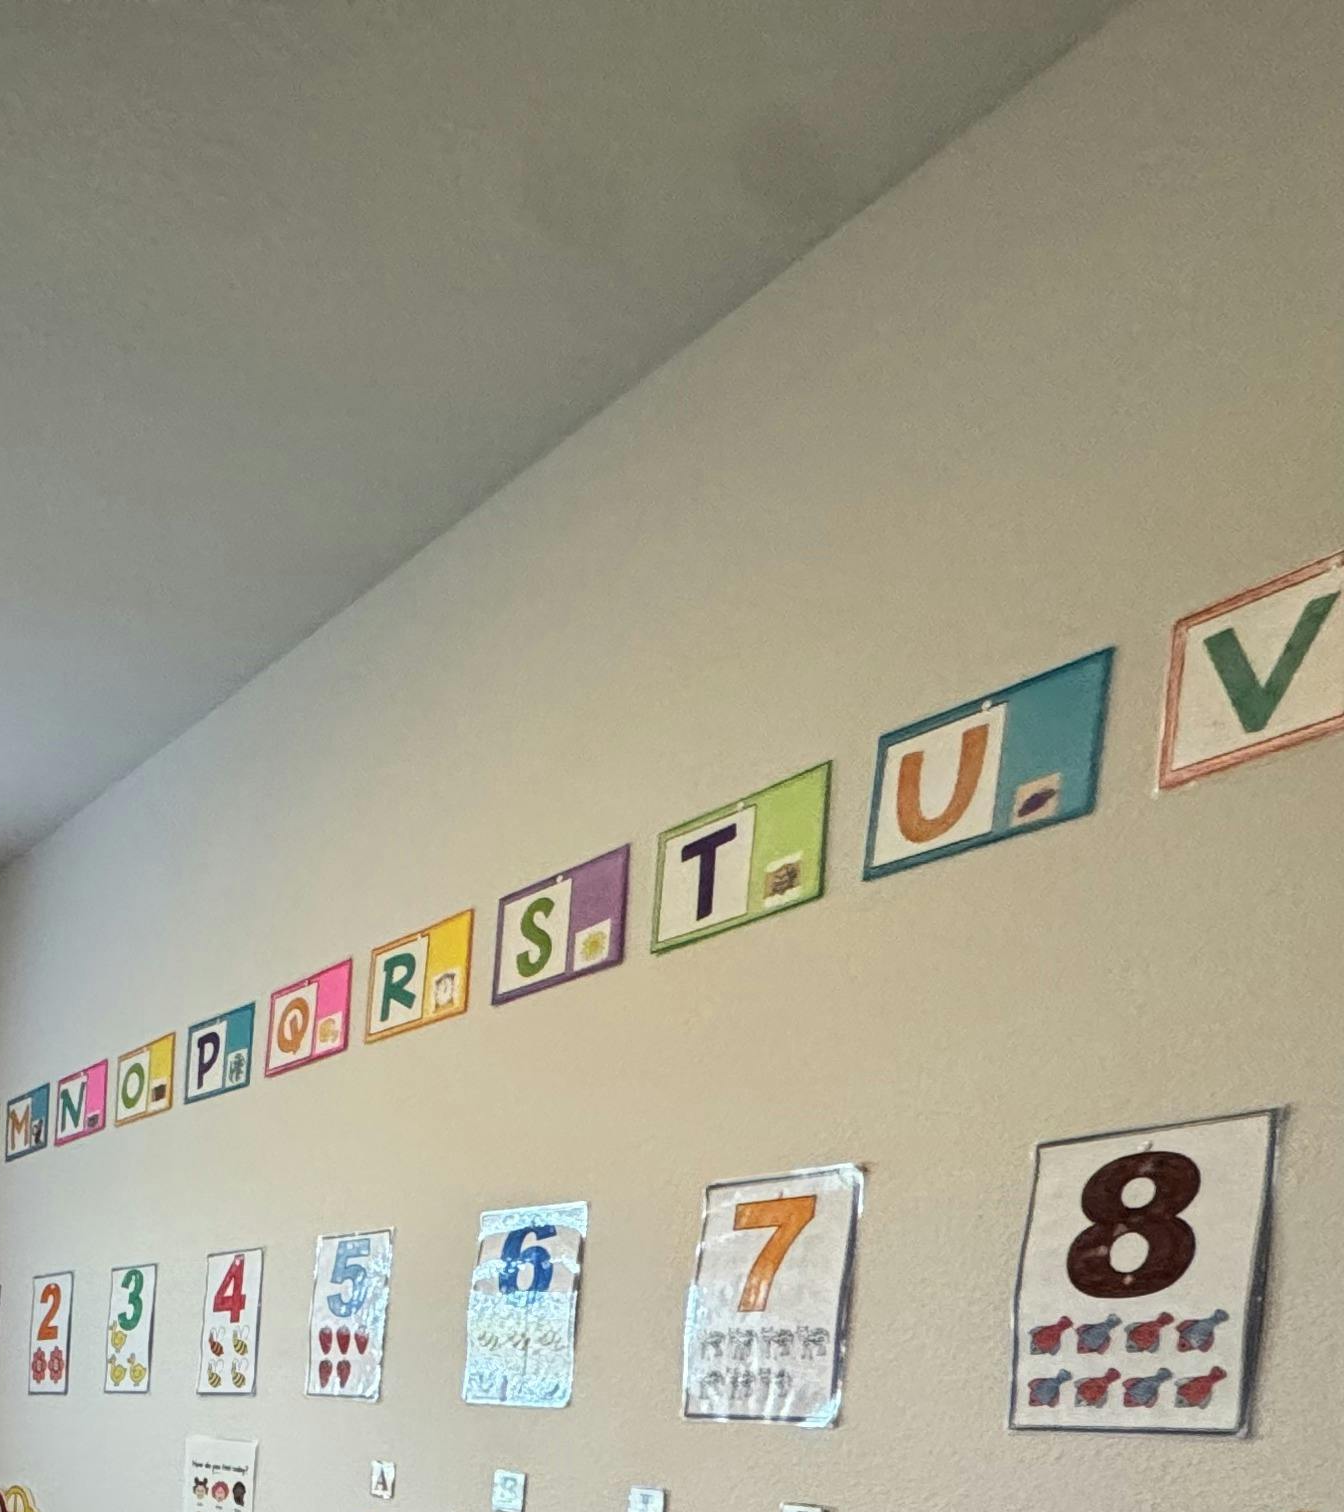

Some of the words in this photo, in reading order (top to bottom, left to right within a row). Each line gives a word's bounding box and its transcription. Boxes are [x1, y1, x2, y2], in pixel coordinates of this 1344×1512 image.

[1203, 590, 1341, 733] V
[896, 724, 990, 844] U
[681, 822, 737, 922] T
[516, 897, 554, 978] S
[380, 952, 417, 1022] R
[278, 997, 310, 1054] Q
[121, 1062, 145, 1109] O
[197, 1031, 220, 1090] P
[9, 1104, 30, 1150] M
[60, 1082, 85, 1134] N
[733, 1194, 817, 1312] 7
[1067, 1151, 1201, 1298] 8
[213, 1254, 246, 1323] 4
[327, 1239, 371, 1318] 5
[498, 1224, 557, 1305] 6
[37, 1283, 61, 1340] 2
[117, 1268, 144, 1331] 3
[375, 1464, 390, 1494] A
